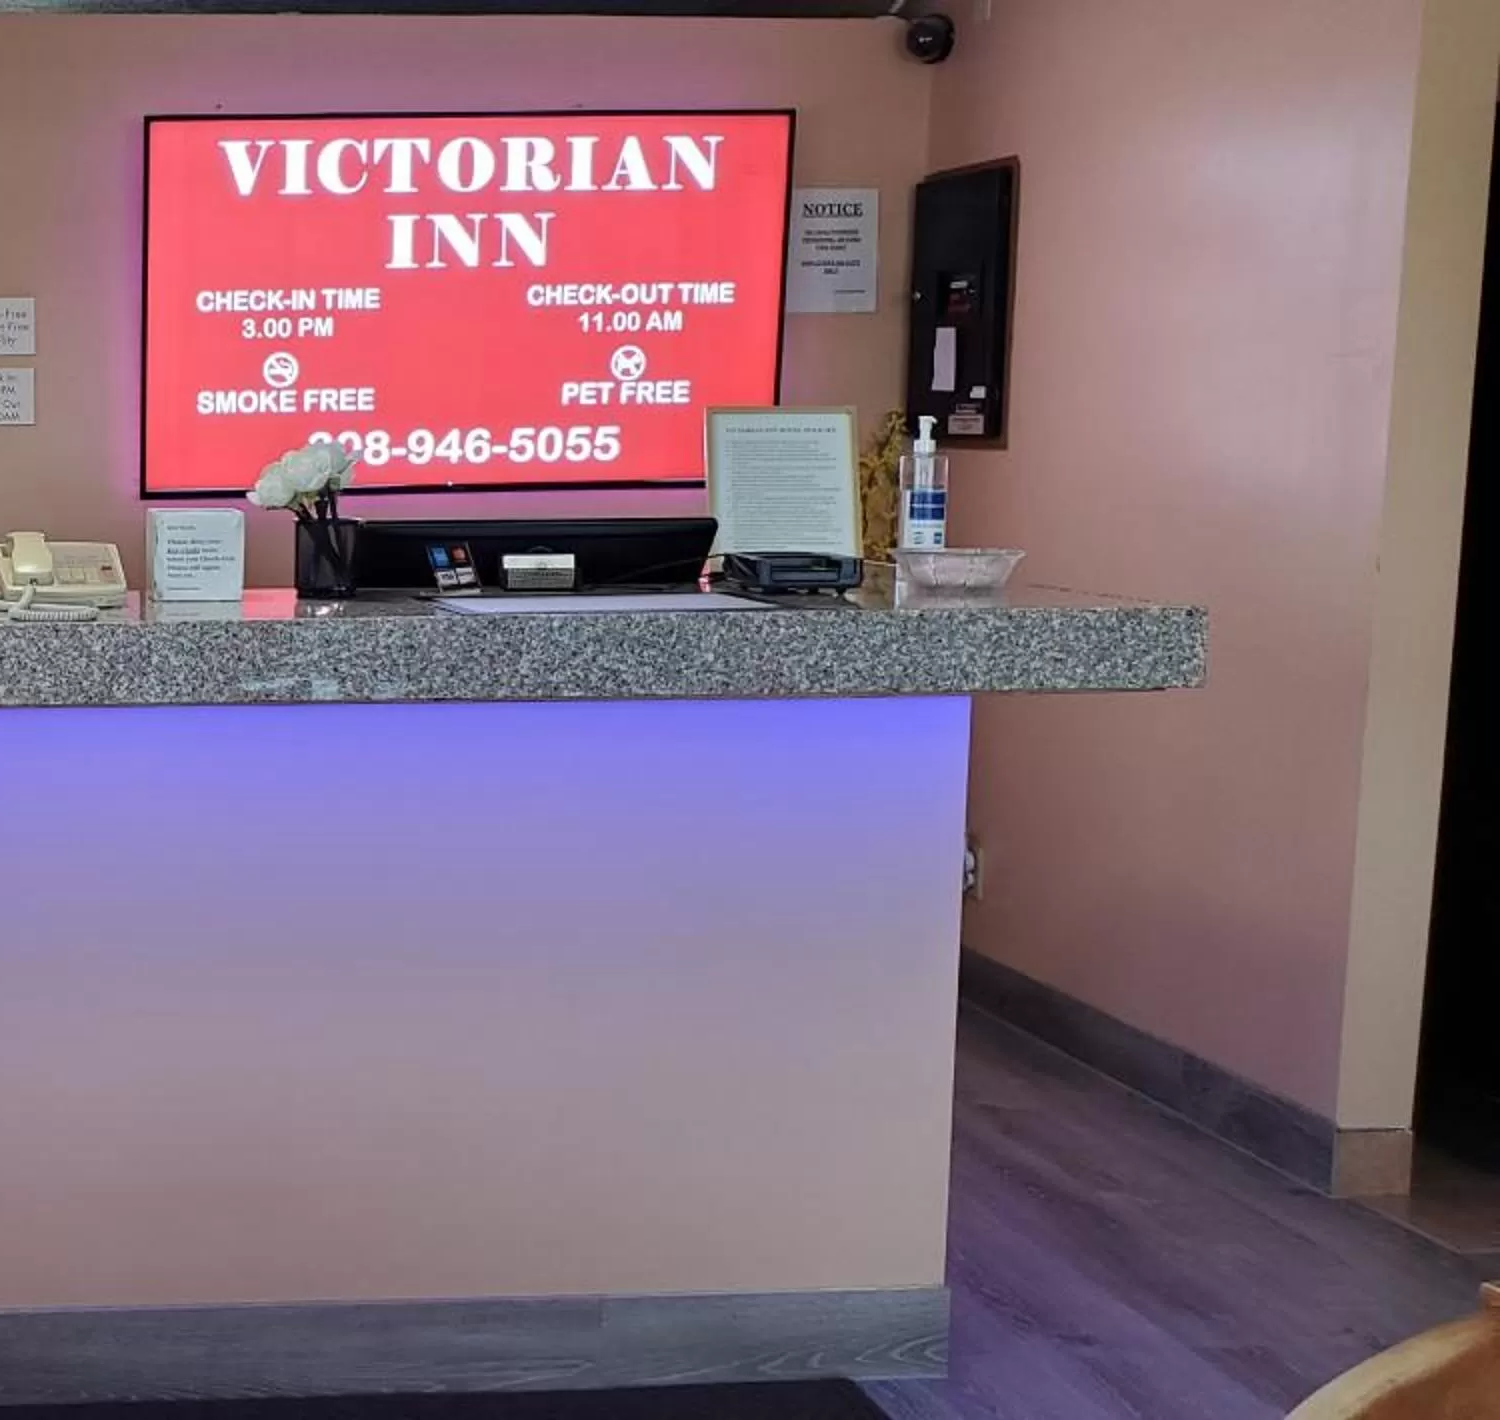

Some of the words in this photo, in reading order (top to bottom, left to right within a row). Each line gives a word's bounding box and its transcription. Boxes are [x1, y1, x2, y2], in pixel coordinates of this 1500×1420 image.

[218, 135, 724, 196] VICTORIAN
[802, 202, 863, 218] NOTICE
[385, 212, 555, 270] INN
[195, 289, 317, 312] CHECK-IN
[321, 287, 381, 310] TIME
[526, 283, 675, 307] CHECK-OUT
[678, 281, 736, 305] TIME
[241, 317, 293, 339] 3.00
[297, 316, 334, 338] PM
[578, 310, 642, 332] 11.00
[645, 310, 684, 332] AM
[196, 389, 299, 415] SMOKE
[302, 387, 376, 413] FREE
[560, 381, 616, 406] PET
[619, 379, 691, 405] FREE
